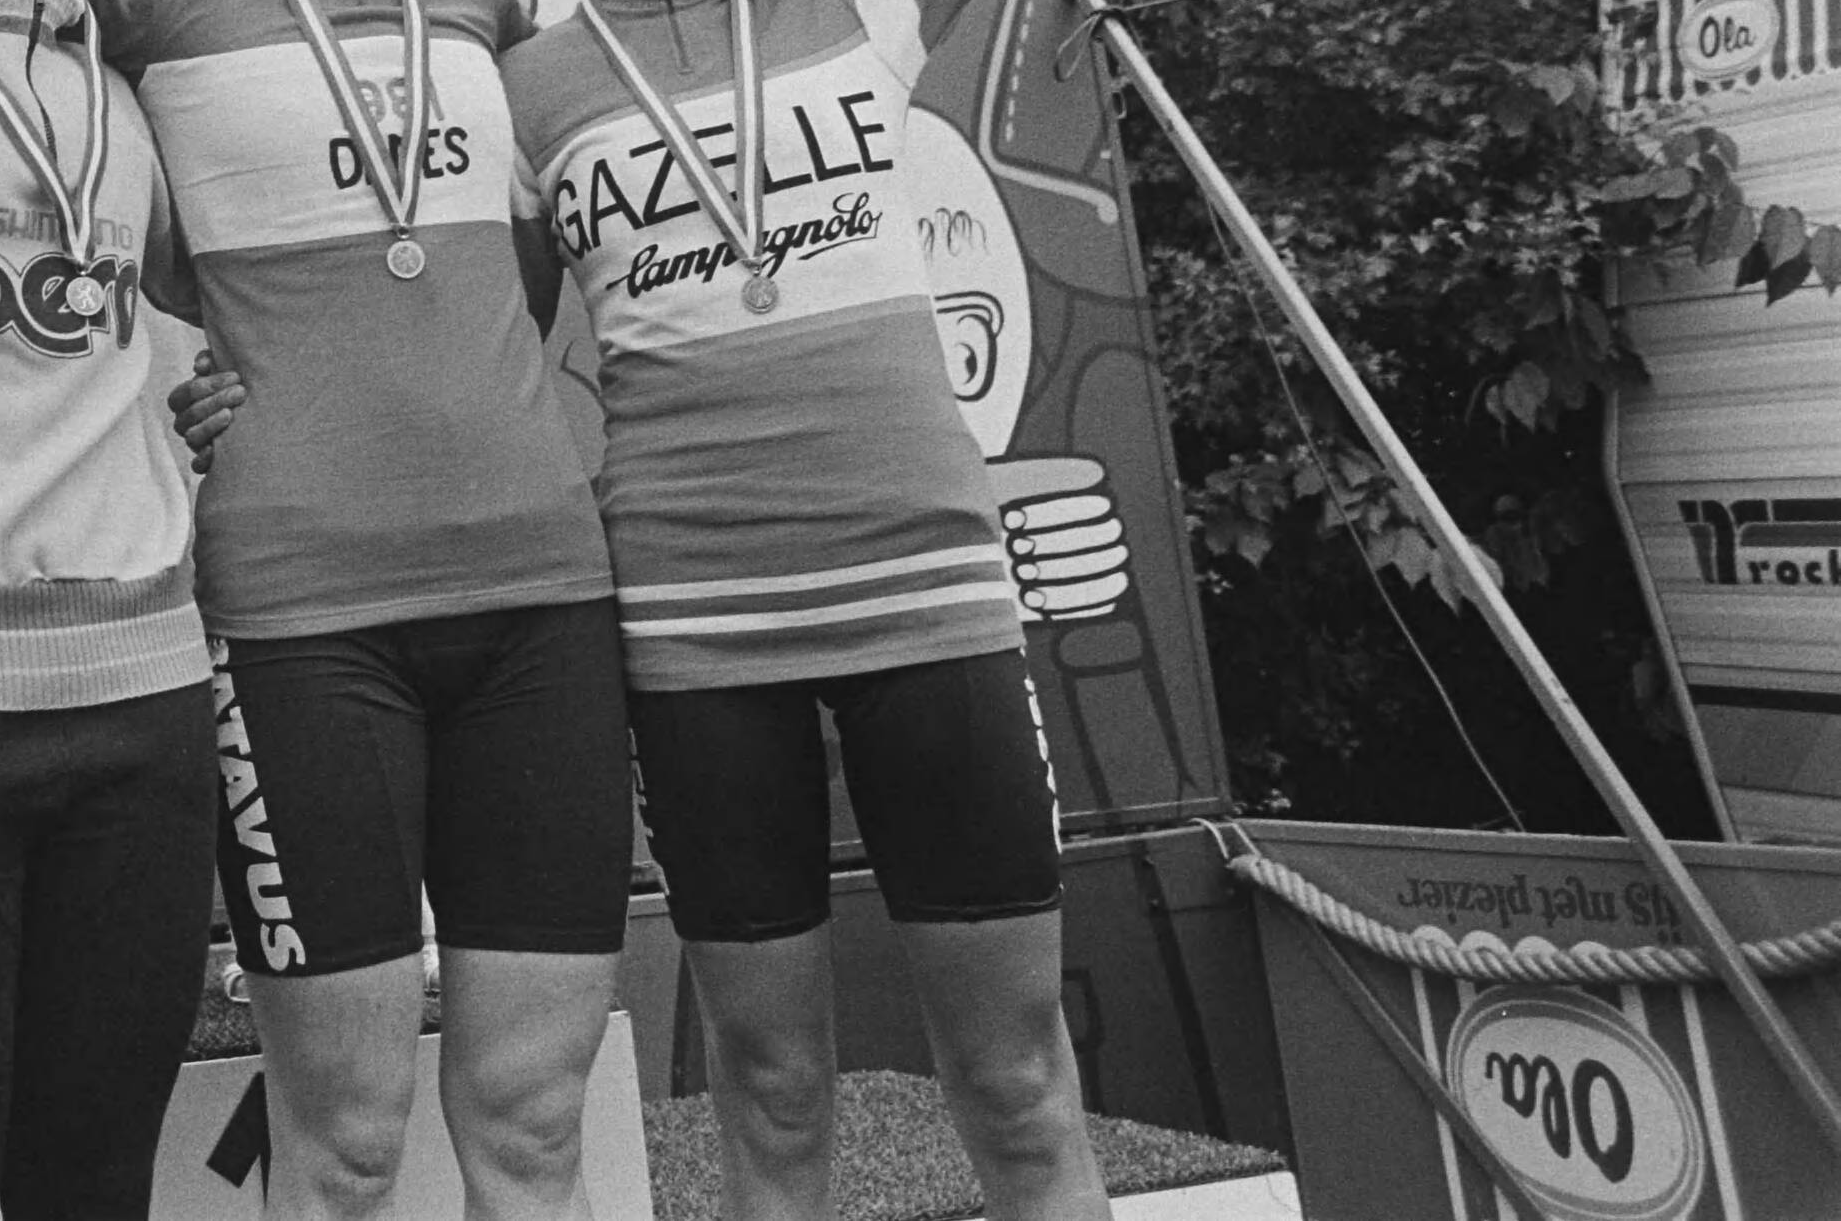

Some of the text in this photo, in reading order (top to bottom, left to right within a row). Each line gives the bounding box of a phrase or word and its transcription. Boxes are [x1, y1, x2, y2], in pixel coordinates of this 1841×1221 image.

[1700, 16, 1756, 58] Ola
[1398, 874, 1532, 928] plezier
[1536, 876, 1618, 927] met
[1485, 1052, 1634, 1183] Ola
